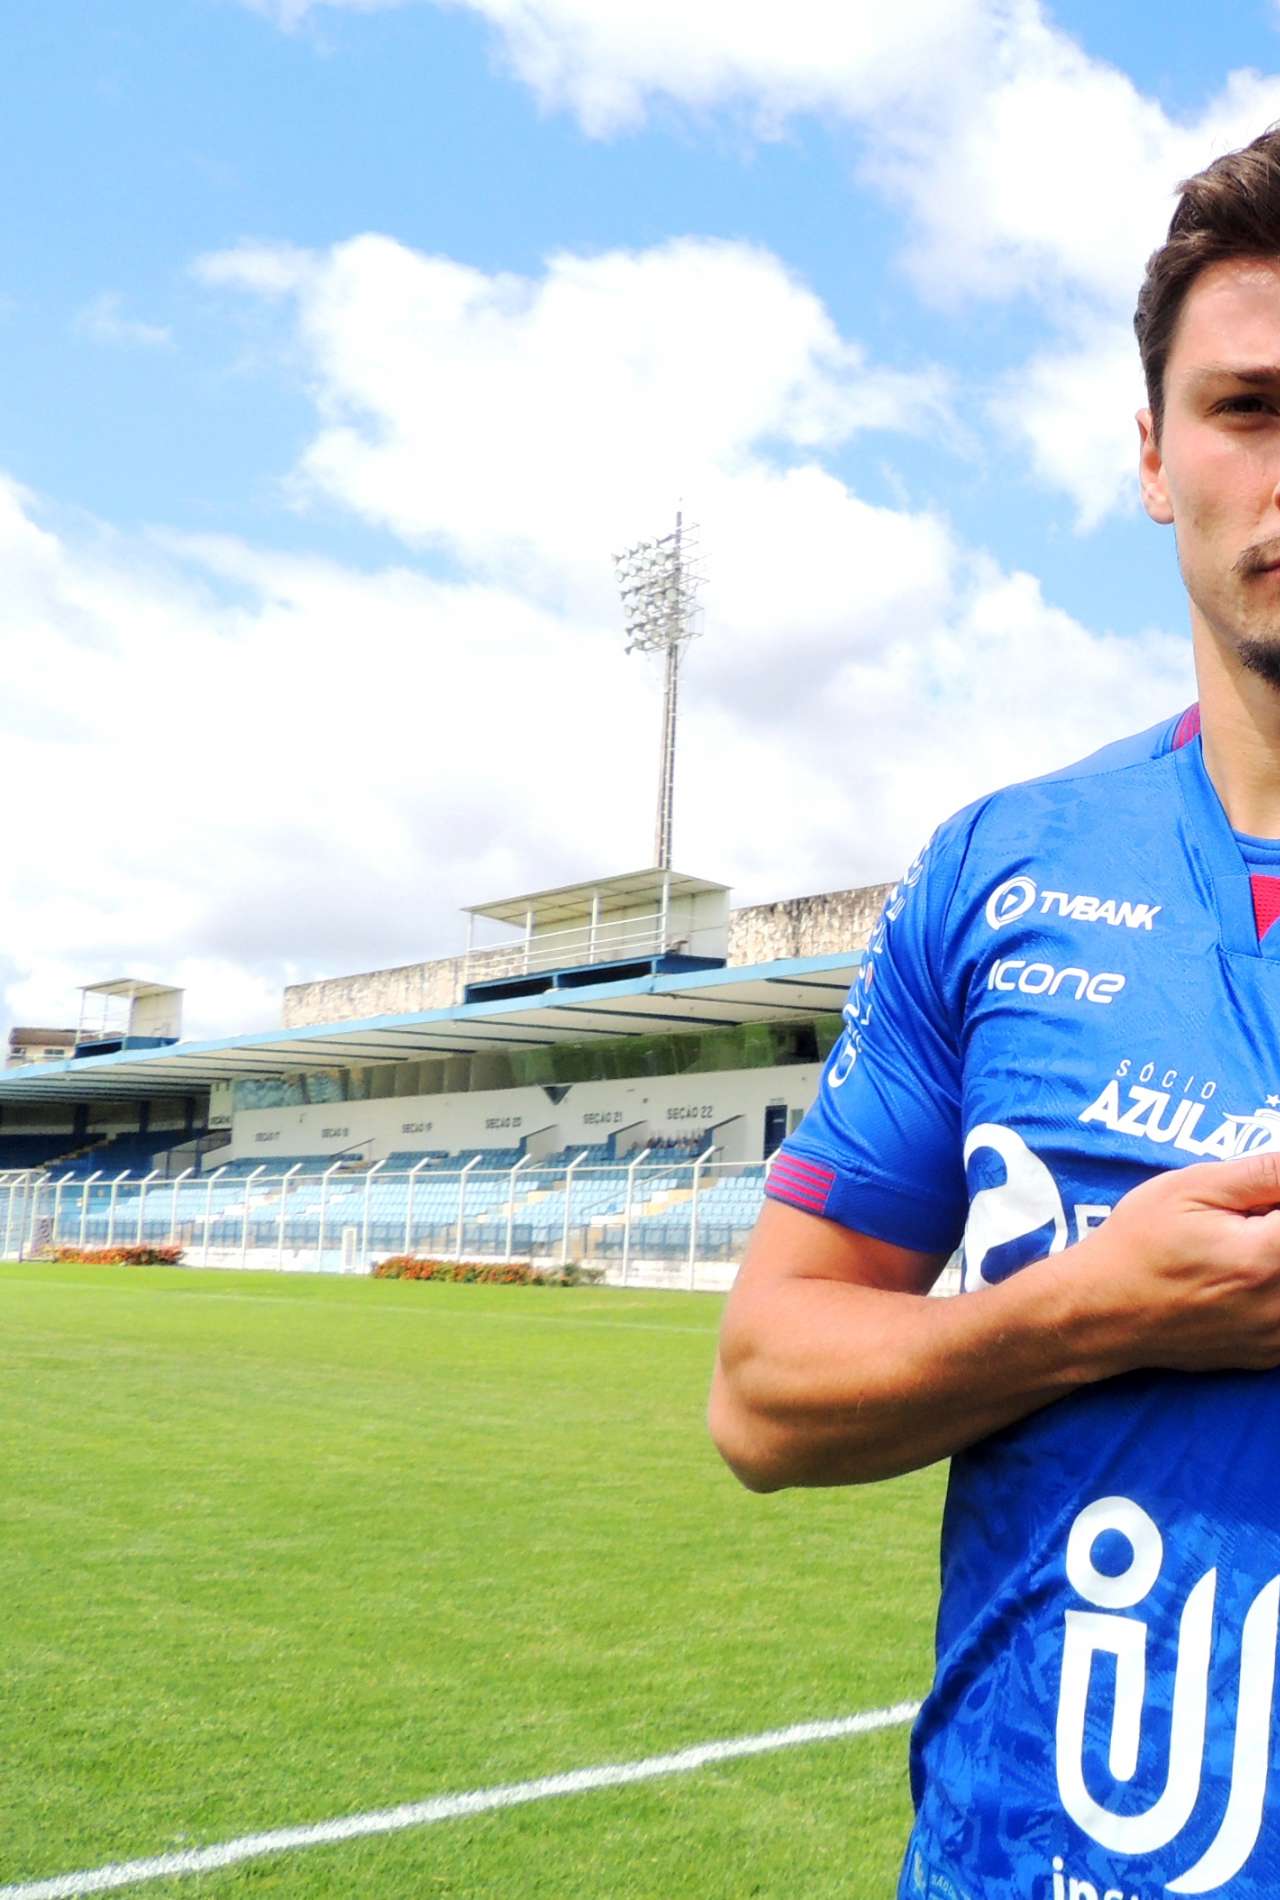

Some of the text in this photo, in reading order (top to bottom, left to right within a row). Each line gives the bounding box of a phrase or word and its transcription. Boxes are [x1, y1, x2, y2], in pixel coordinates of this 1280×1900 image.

[1039, 890, 1162, 930] TVBANK
[1116, 1058, 1217, 1100] SÓCIO
[700, 1105, 713, 1119] 22
